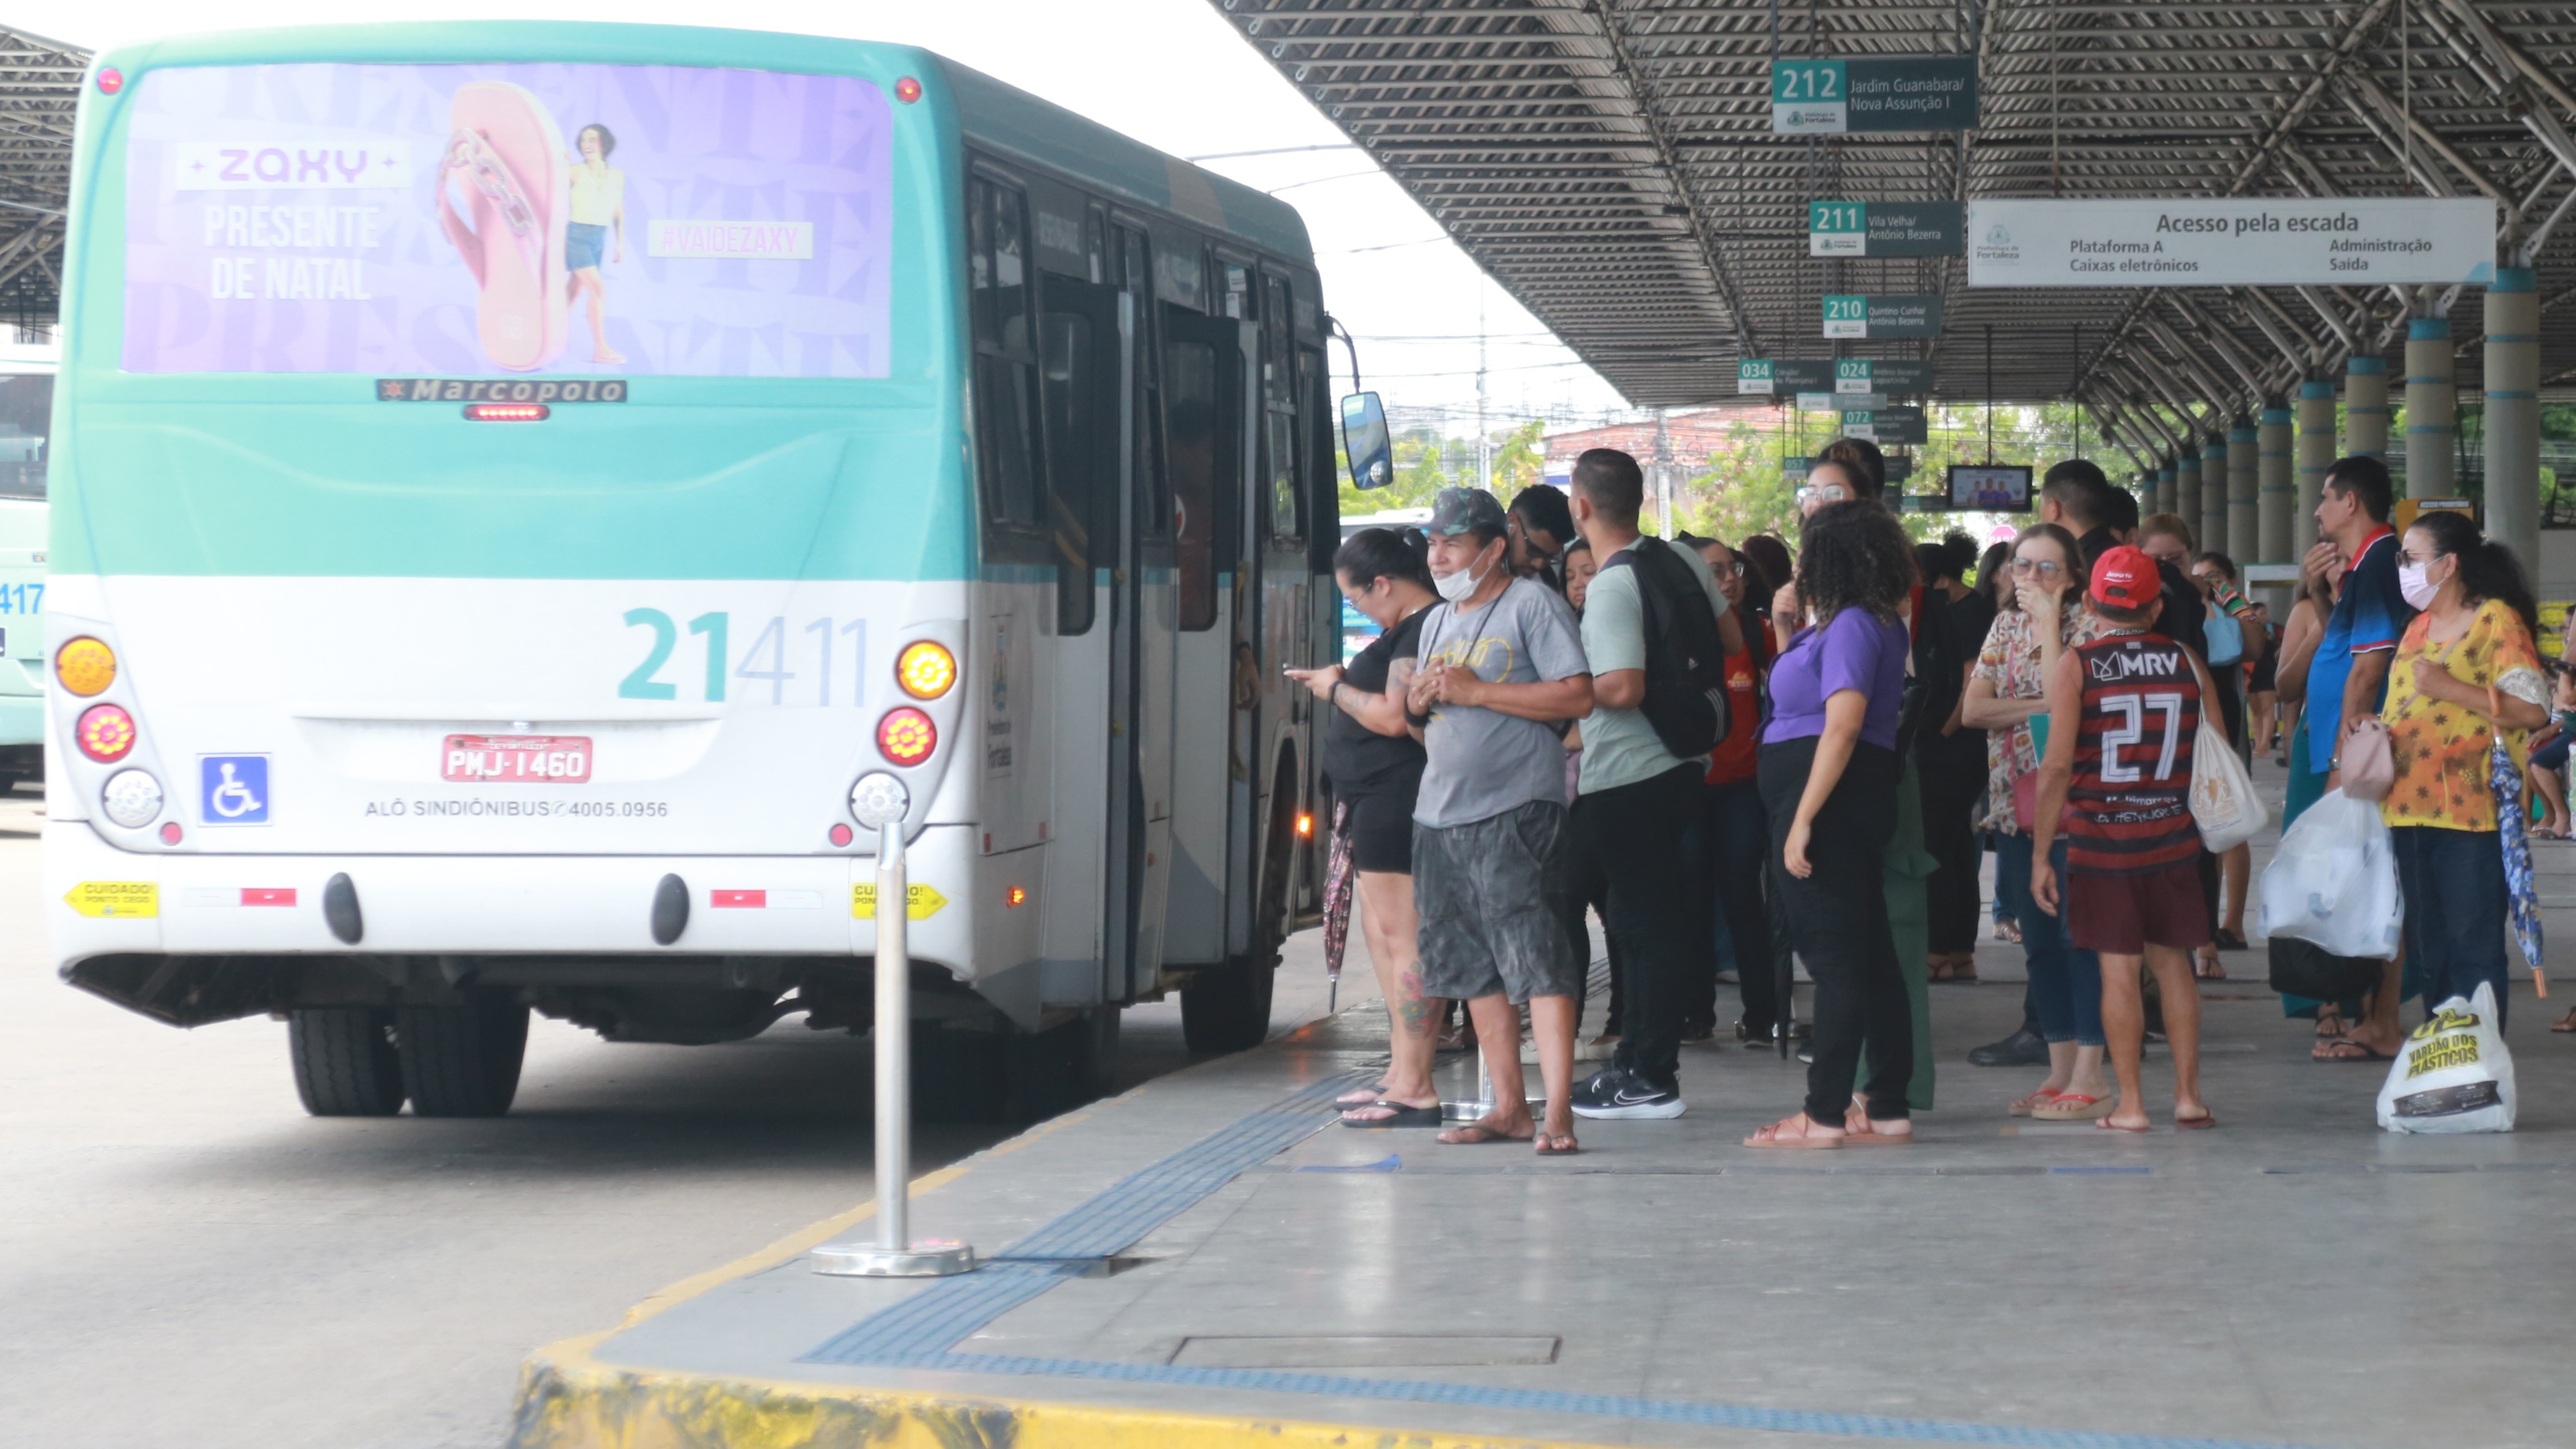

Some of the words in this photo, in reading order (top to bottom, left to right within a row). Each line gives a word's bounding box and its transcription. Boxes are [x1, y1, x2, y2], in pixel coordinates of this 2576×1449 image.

[1782, 69, 1836, 98] 212
[1850, 79, 1890, 93] Jardim
[1893, 77, 1965, 92] Guanabara/
[1851, 97, 1881, 110] Nova
[1884, 96, 1942, 112] Assunção
[1946, 97, 1950, 108] I
[205, 205, 380, 248] PRESENTE
[1817, 208, 1856, 229] 211
[1868, 217, 1885, 227] Vila
[1887, 216, 1916, 227] Velha/
[2155, 214, 2228, 232] Acesso
[2235, 213, 2280, 236] pela
[2287, 212, 2359, 232] escada
[662, 225, 798, 254] #VAIDEZAXY
[1868, 230, 1904, 240] Antônio
[1907, 230, 1941, 239] Bezerra
[2070, 240, 2148, 253] Plataforma
[2153, 241, 2163, 253] A
[2330, 239, 2432, 255] Administração
[2070, 259, 2115, 271] Caixas
[2119, 258, 2198, 271] eletrônicos
[2330, 258, 2368, 271] Saída
[212, 258, 255, 299] DE
[265, 258, 371, 300] NATAL
[1830, 301, 1861, 318] 210
[1868, 307, 1898, 316] Quintino
[1900, 306, 1926, 315] Cunha/
[1868, 317, 1895, 326] Antônio
[1742, 364, 1769, 378] 034
[1840, 363, 1867, 377] 024
[412, 379, 623, 402] Marcopolo
[1847, 412, 1869, 423] 072
[618, 607, 868, 707] 21411
[2120, 653, 2178, 676] MRV
[2100, 693, 2182, 782] 27
[447, 751, 585, 777] PMJ-1460
[364, 797, 406, 816] ALÔ
[412, 797, 550, 816] SINDIÔNIBUS
[568, 802, 668, 816] 4005.0956
[2409, 1037, 2449, 1064] VAREJÃO
[2452, 1034, 2477, 1047] DOS
